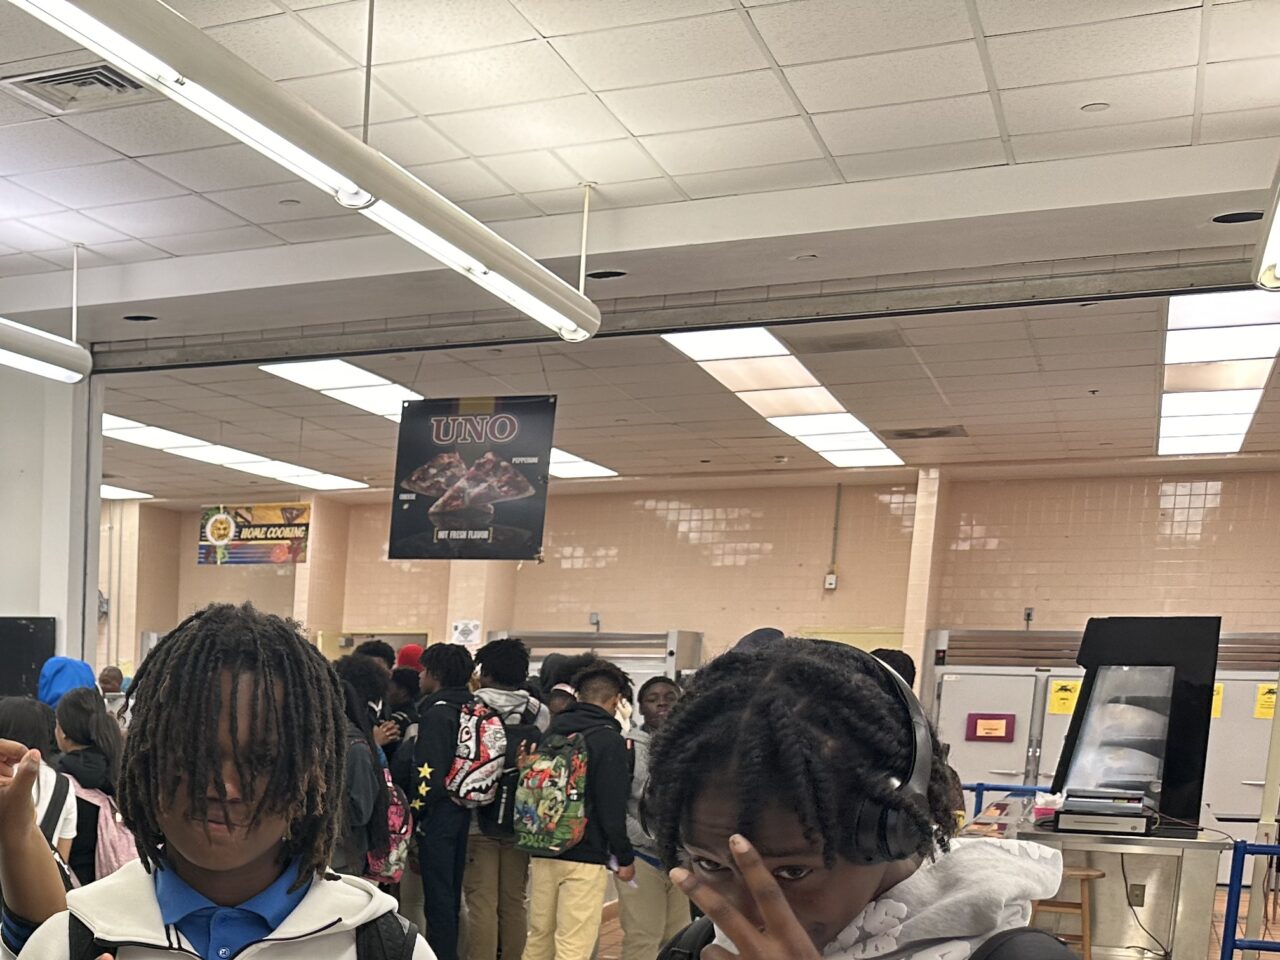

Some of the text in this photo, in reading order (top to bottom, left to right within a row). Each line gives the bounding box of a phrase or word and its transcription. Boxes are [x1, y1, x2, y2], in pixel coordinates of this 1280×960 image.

[431, 414, 518, 444] UNO
[240, 526, 306, 539] HOME COOKING
